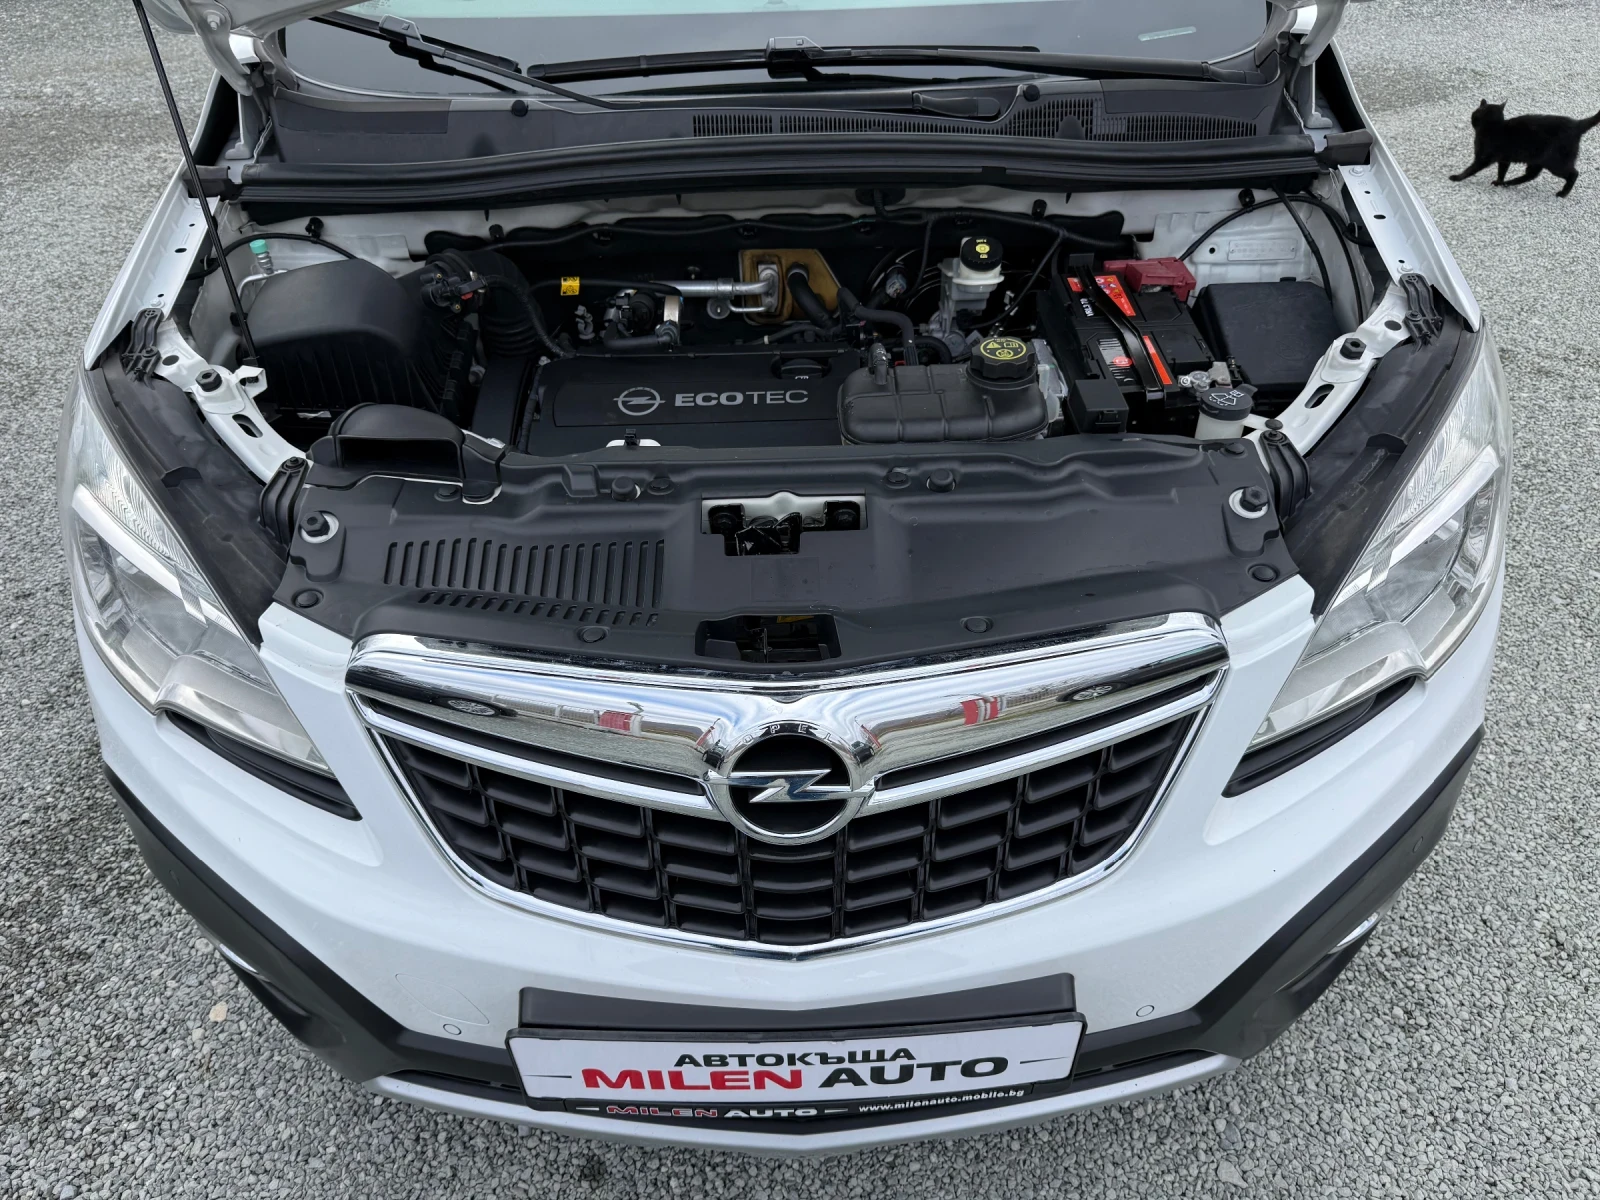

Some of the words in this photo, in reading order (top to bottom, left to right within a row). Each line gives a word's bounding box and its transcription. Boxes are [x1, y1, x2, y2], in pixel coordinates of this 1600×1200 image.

[674, 389, 809, 407] ECOTEC
[743, 723, 833, 745] OPEL
[581, 1068, 802, 1091] MILEN
[817, 1056, 1009, 1089] AUTO
[605, 1105, 718, 1119] MILEN
[724, 1108, 818, 1118] AUTO
[858, 1090, 1025, 1112] www.milenauto.mobile.bg
